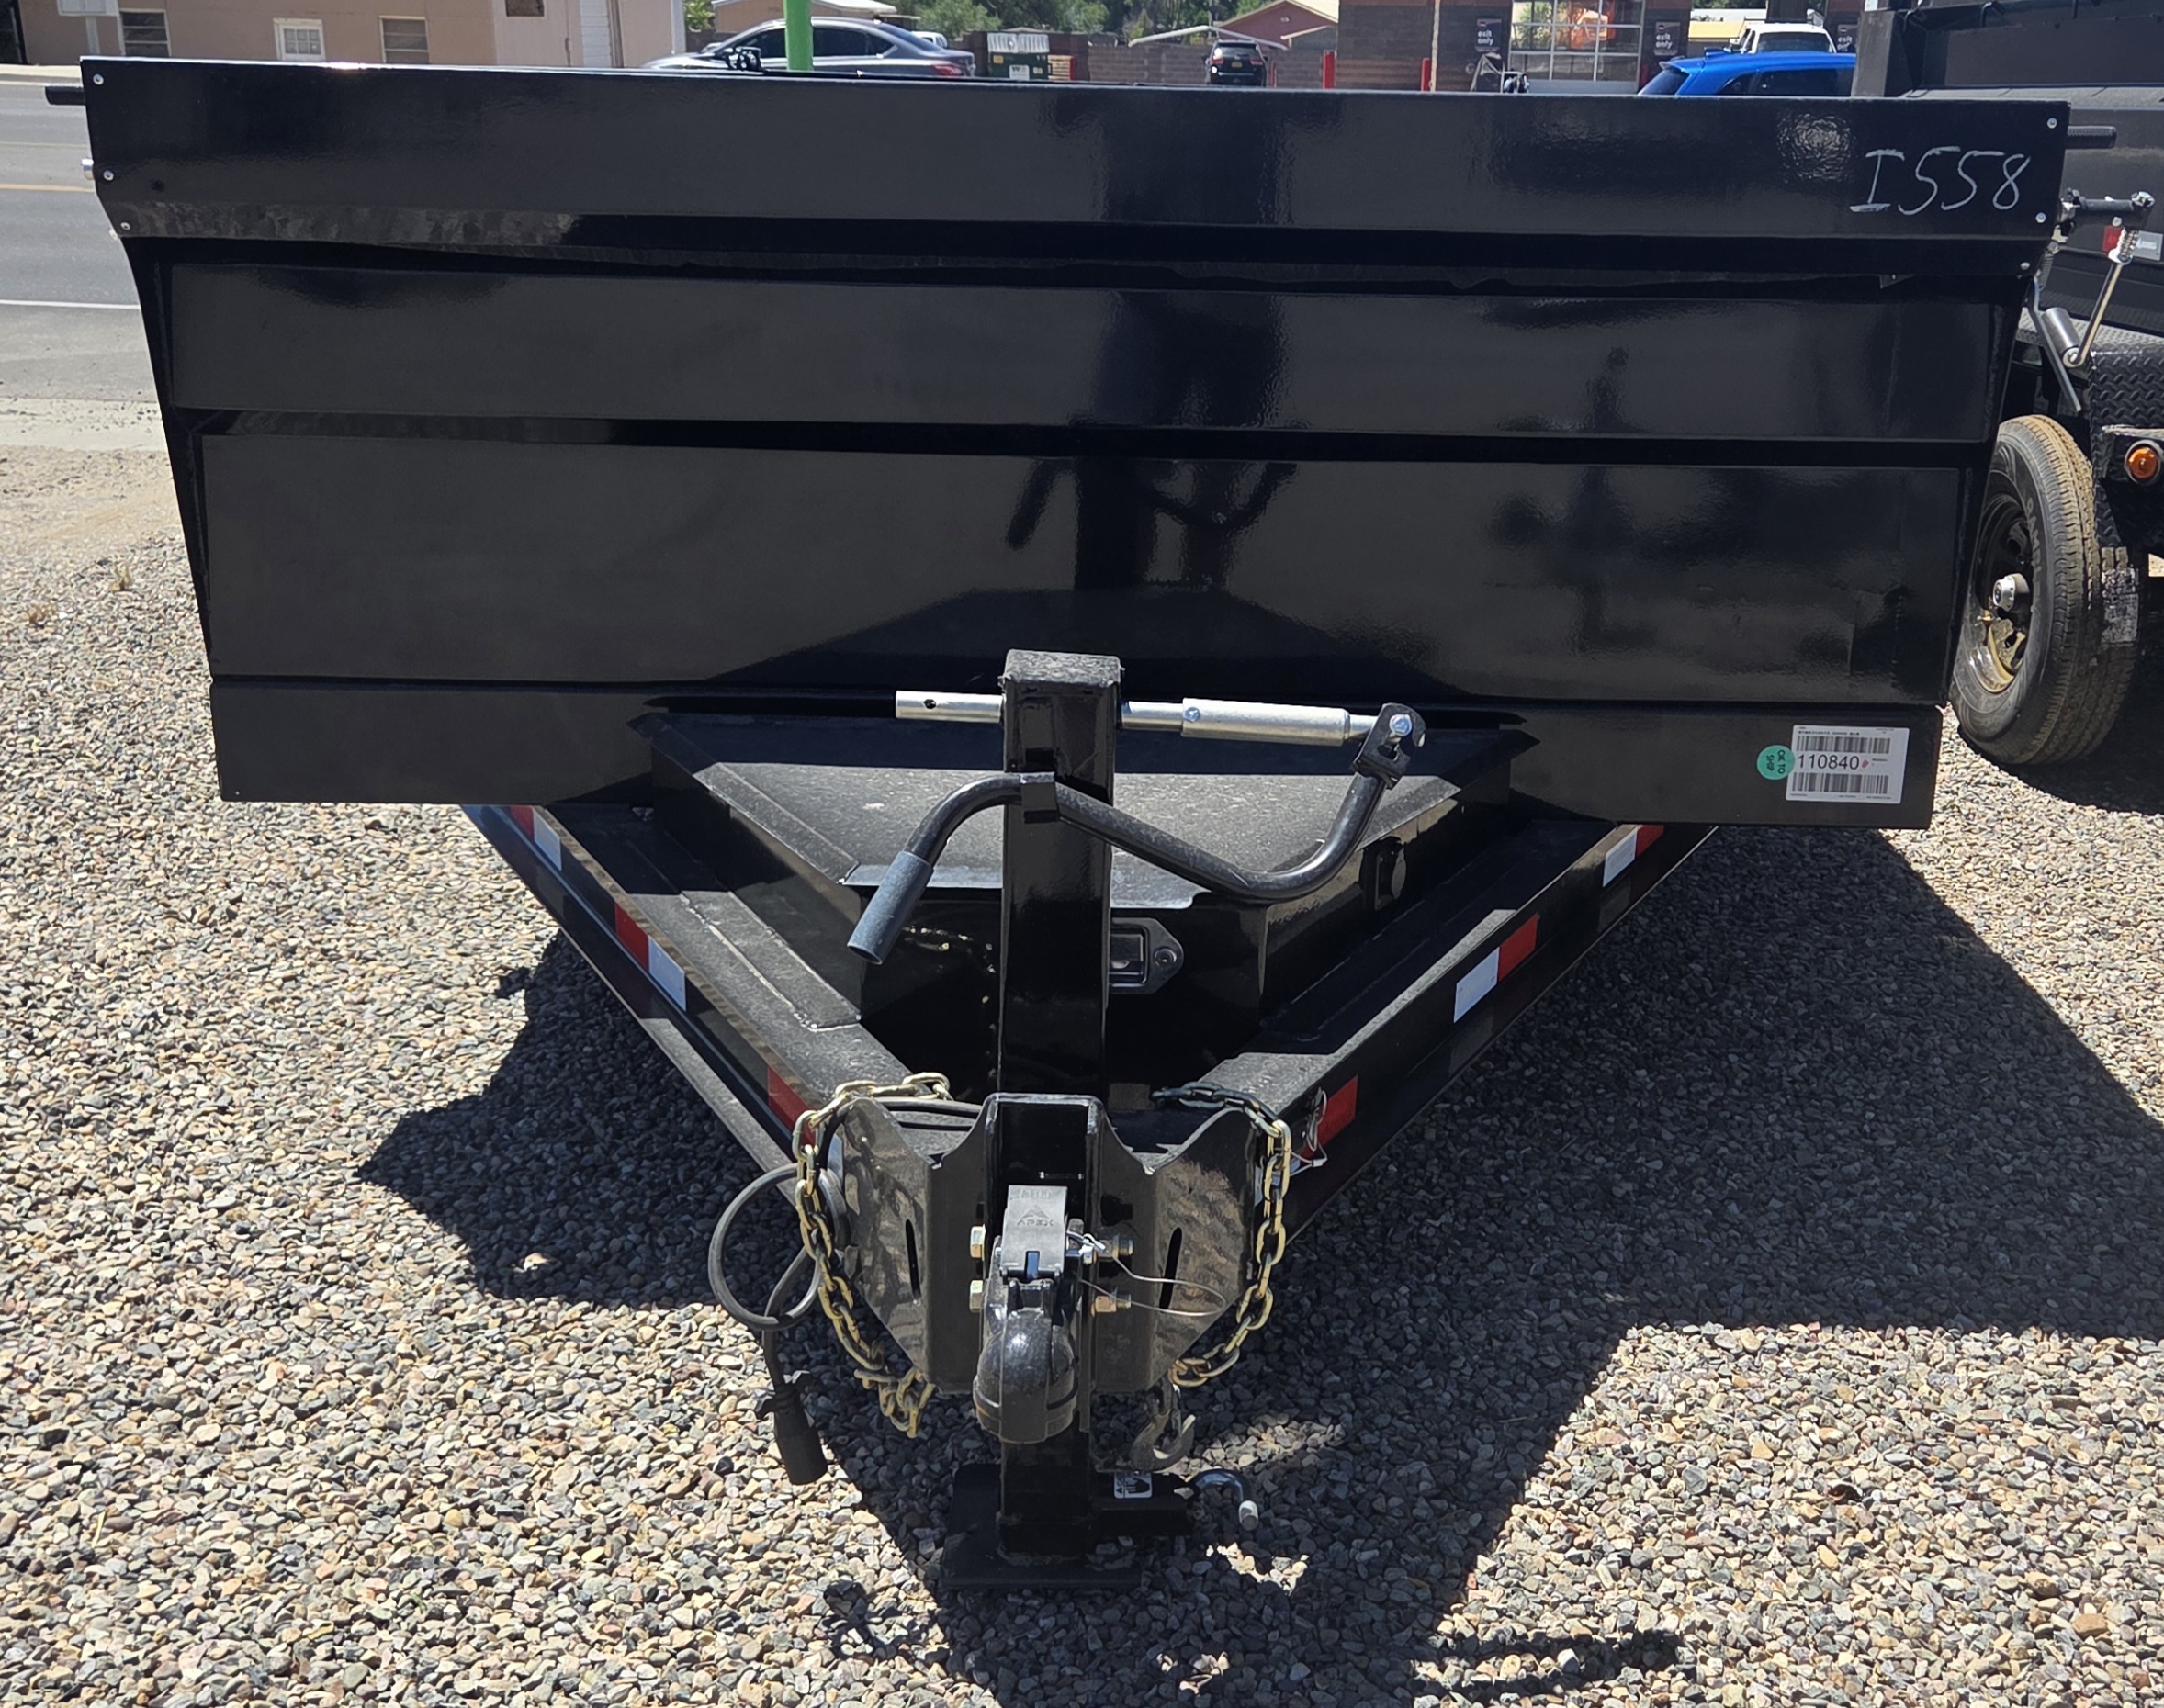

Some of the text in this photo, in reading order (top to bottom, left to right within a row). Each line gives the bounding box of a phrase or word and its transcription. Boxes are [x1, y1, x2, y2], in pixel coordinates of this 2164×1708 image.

[1477, 29, 1492, 38] exit
[1655, 33, 1671, 41] exit
[1477, 37, 1493, 46] only
[1655, 40, 1673, 50] only
[1777, 749, 1786, 774] OK TO
[1798, 753, 1860, 770] 110840
